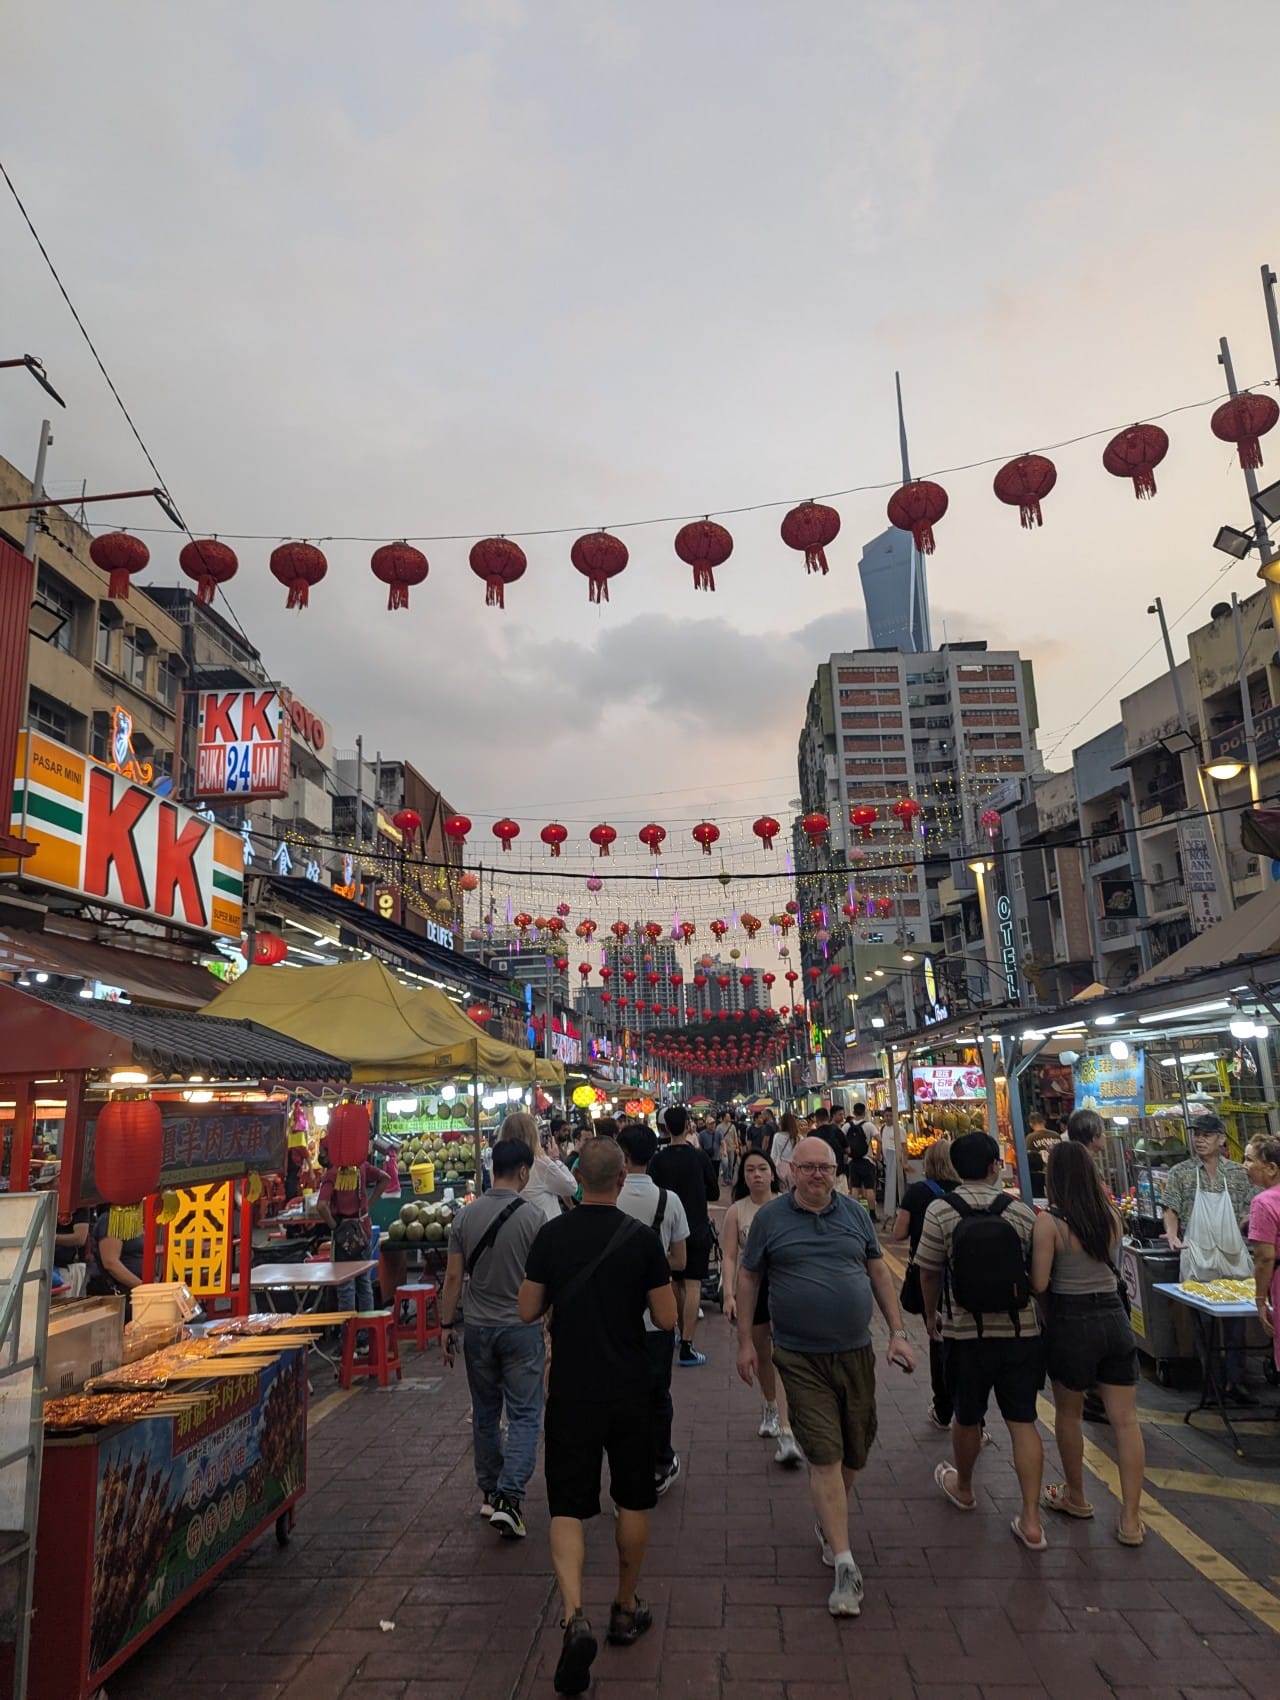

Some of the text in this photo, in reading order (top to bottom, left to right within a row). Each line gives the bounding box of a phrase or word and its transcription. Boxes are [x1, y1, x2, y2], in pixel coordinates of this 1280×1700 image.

[204, 691, 277, 742] KK
[33, 752, 82, 785] PASAR MINI
[199, 745, 279, 791] BUKA 24 JAM
[84, 767, 210, 927] KK
